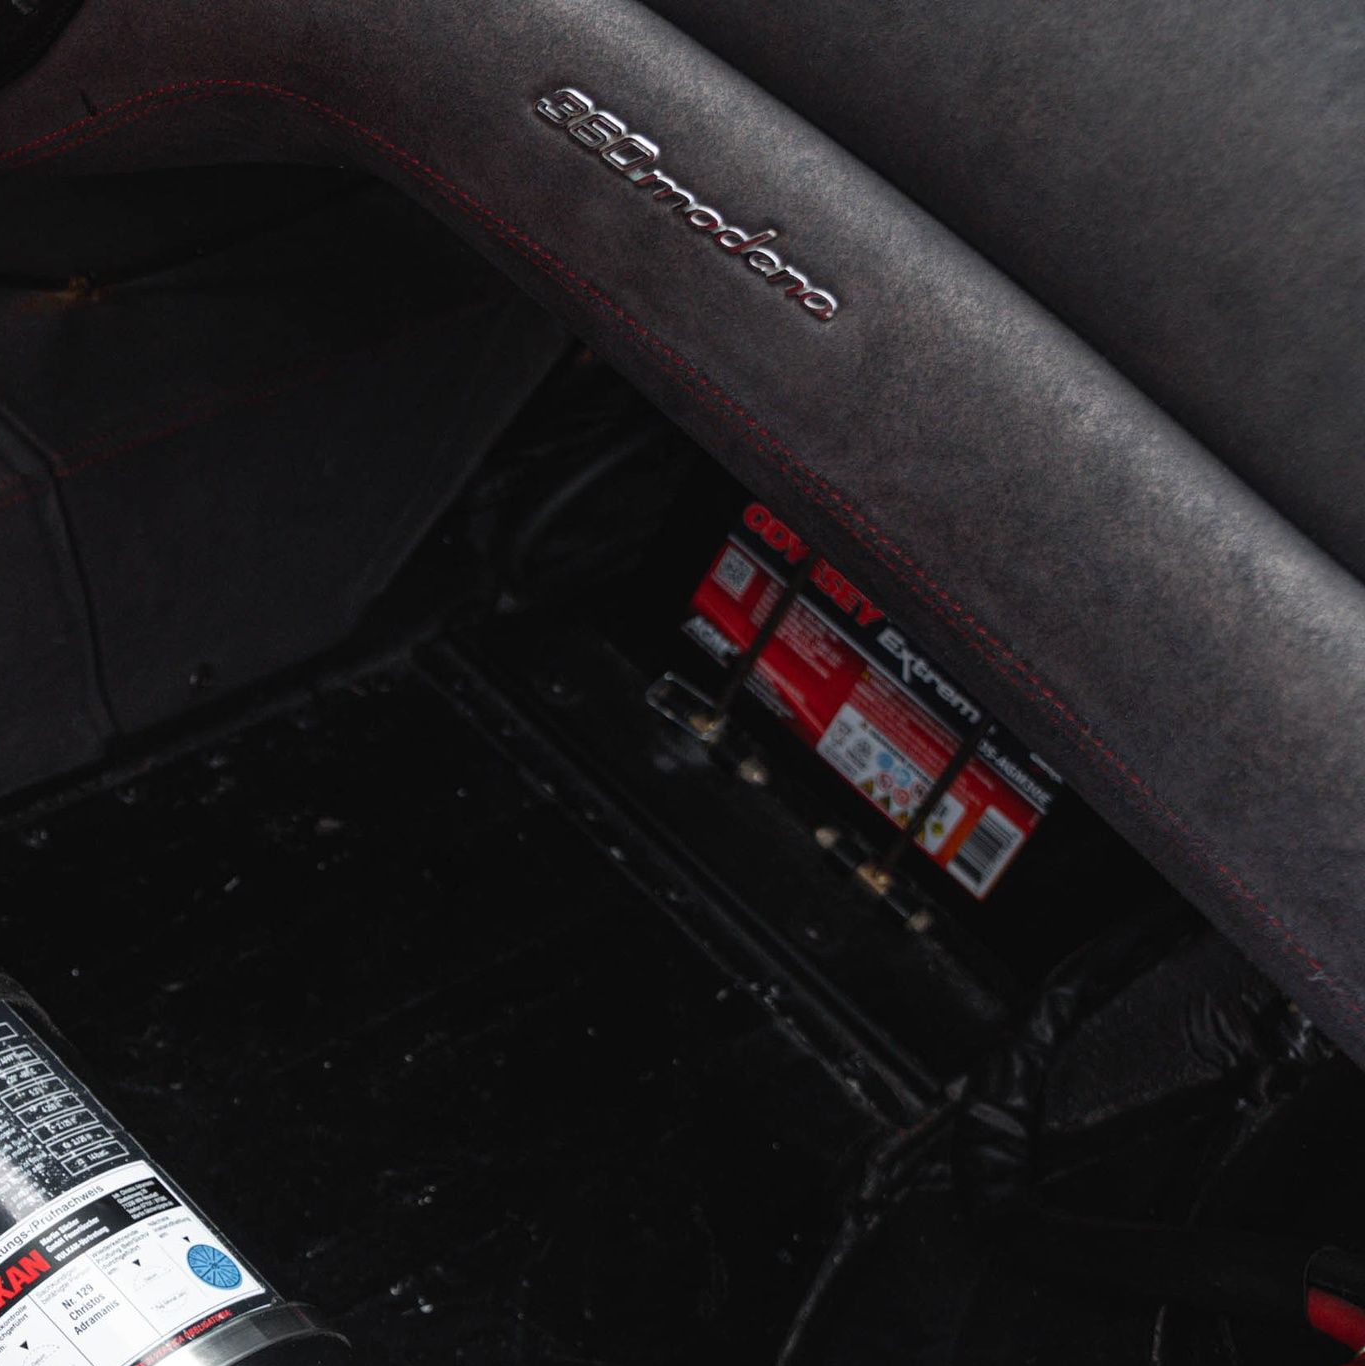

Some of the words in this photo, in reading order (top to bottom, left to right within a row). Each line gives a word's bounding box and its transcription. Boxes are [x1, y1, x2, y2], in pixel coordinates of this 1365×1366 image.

[534, 87, 662, 172] 360
[633, 168, 838, 322] modena
[876, 627, 997, 735] Extrem
[61, 1295, 77, 1310] Nr.
[75, 1282, 94, 1299] 129
[68, 1292, 105, 1321] Christos
[72, 1298, 119, 1335] Adramanis
